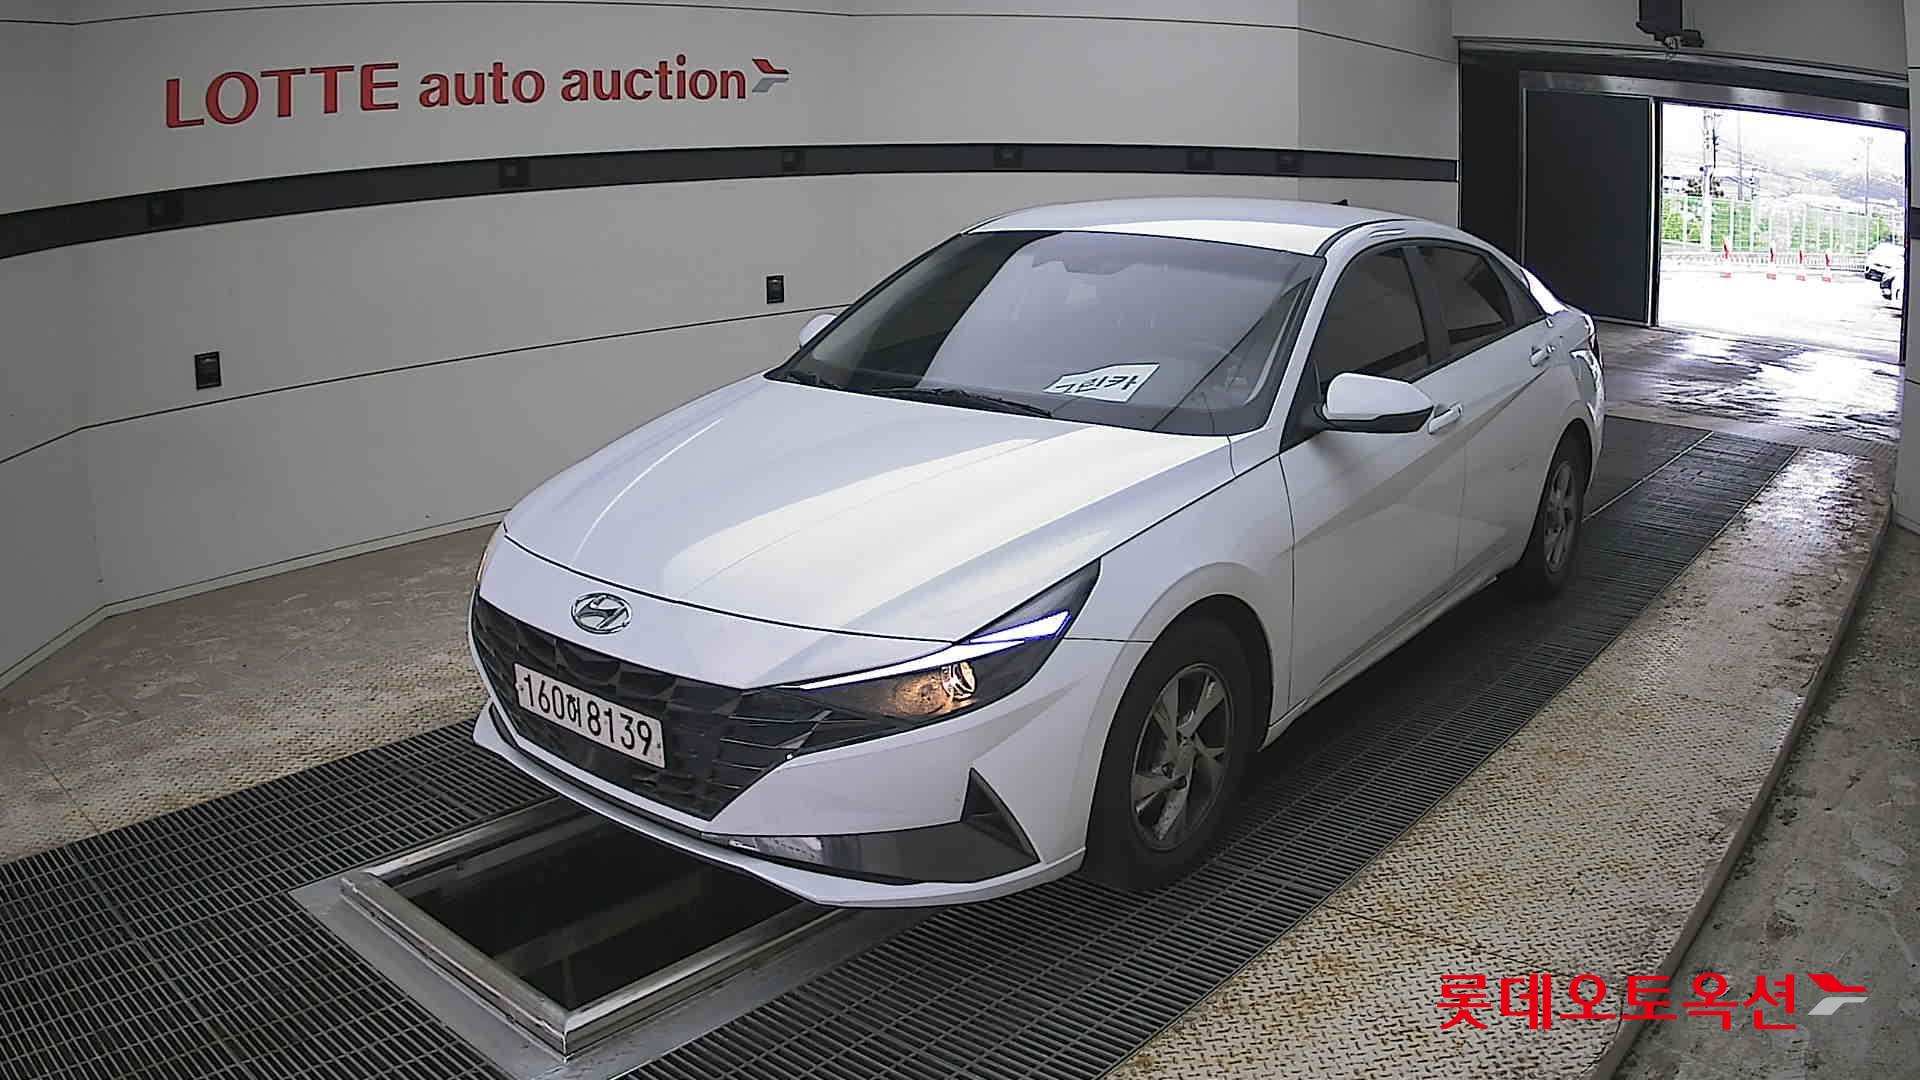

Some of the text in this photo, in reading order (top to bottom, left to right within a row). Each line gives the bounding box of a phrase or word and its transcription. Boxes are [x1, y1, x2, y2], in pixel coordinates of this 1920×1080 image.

[166, 54, 746, 128] LOTTE auto auction
[523, 673, 652, 756] 160허8139
